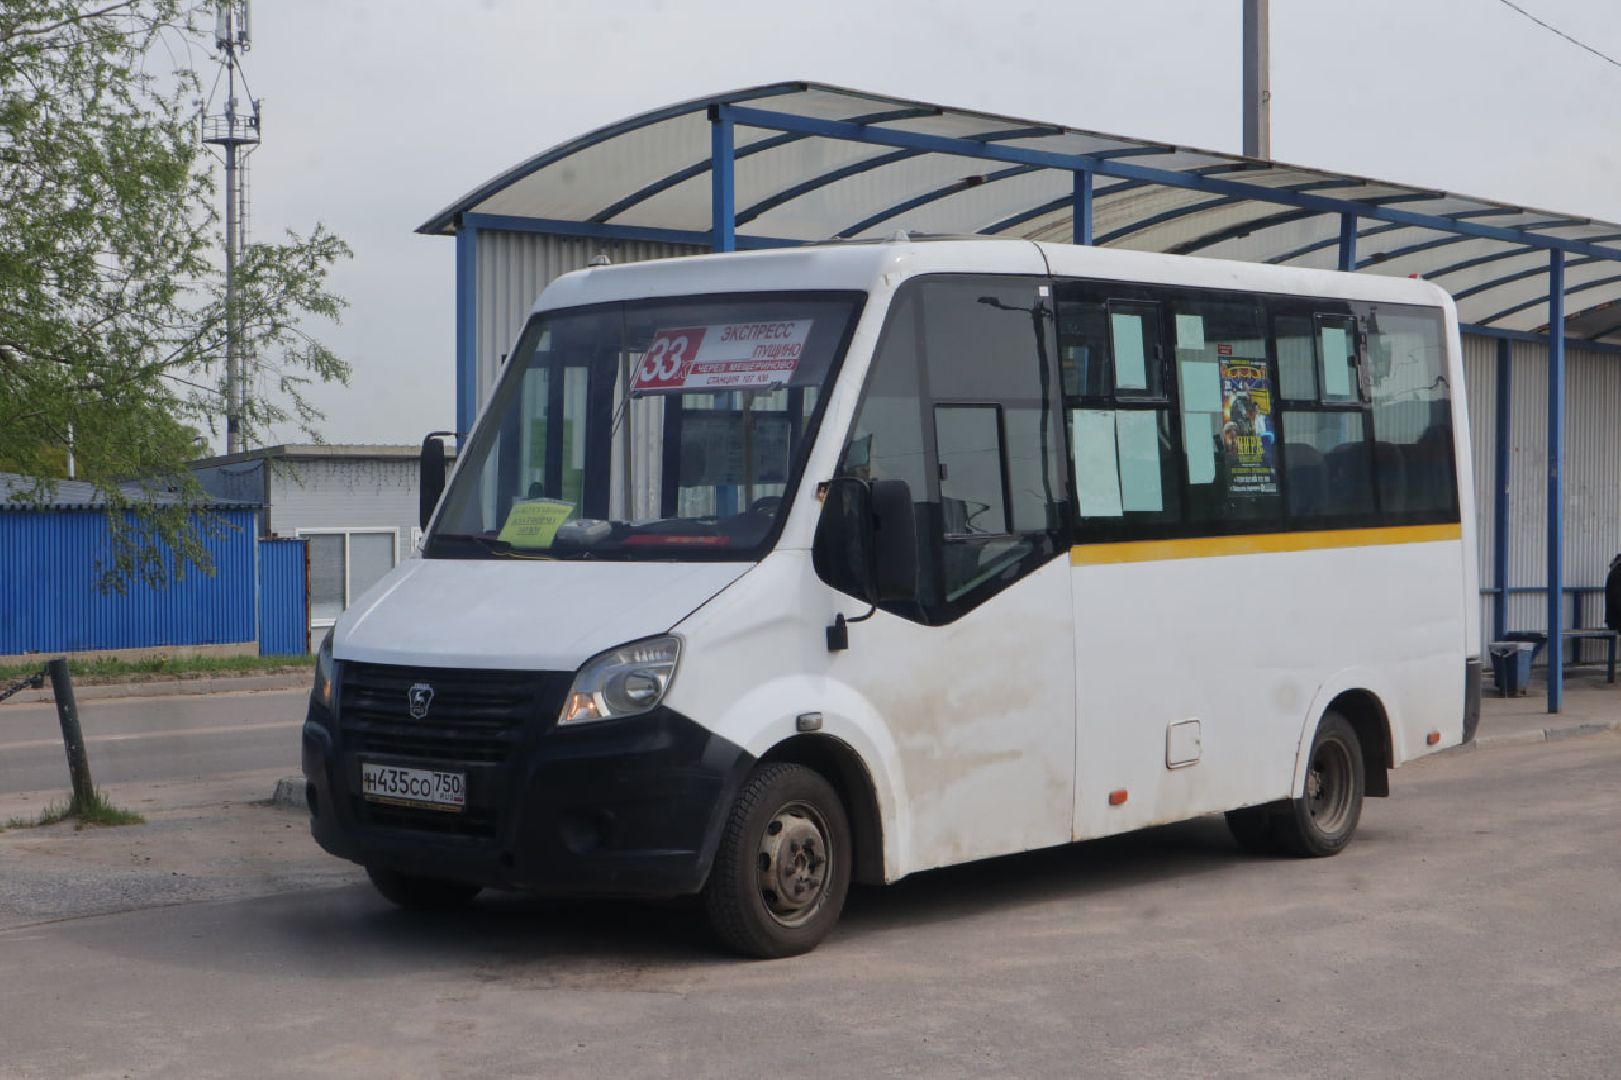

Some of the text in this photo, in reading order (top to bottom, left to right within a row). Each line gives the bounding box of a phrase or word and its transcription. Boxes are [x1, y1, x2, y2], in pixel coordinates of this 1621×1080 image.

[721, 322, 796, 342] ЭКСПРЕСС
[752, 343, 802, 359] ПУЩИНО
[367, 769, 460, 797] Н435СО 750
